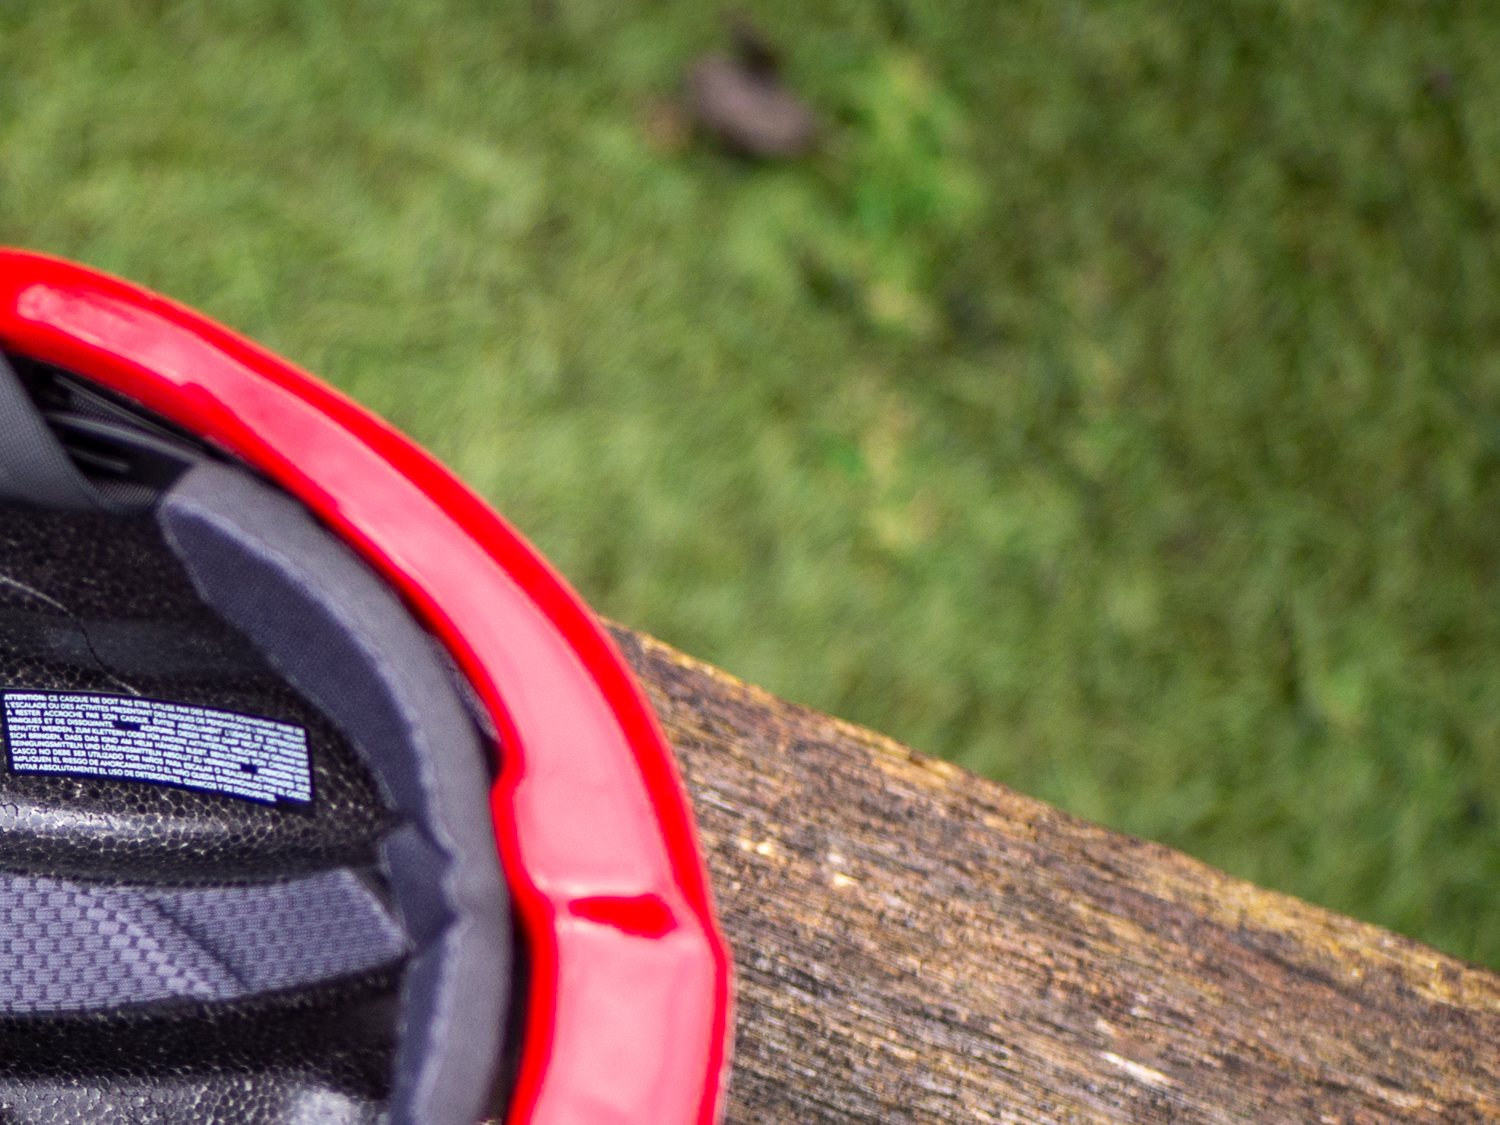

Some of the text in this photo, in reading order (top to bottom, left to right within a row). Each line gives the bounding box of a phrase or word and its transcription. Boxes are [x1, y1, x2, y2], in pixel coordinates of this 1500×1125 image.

[43, 710, 83, 718] ACCROCHE
[88, 751, 124, 760] UTILIZADO
[62, 757, 88, 765] RIESGO
[108, 768, 124, 776] USO
